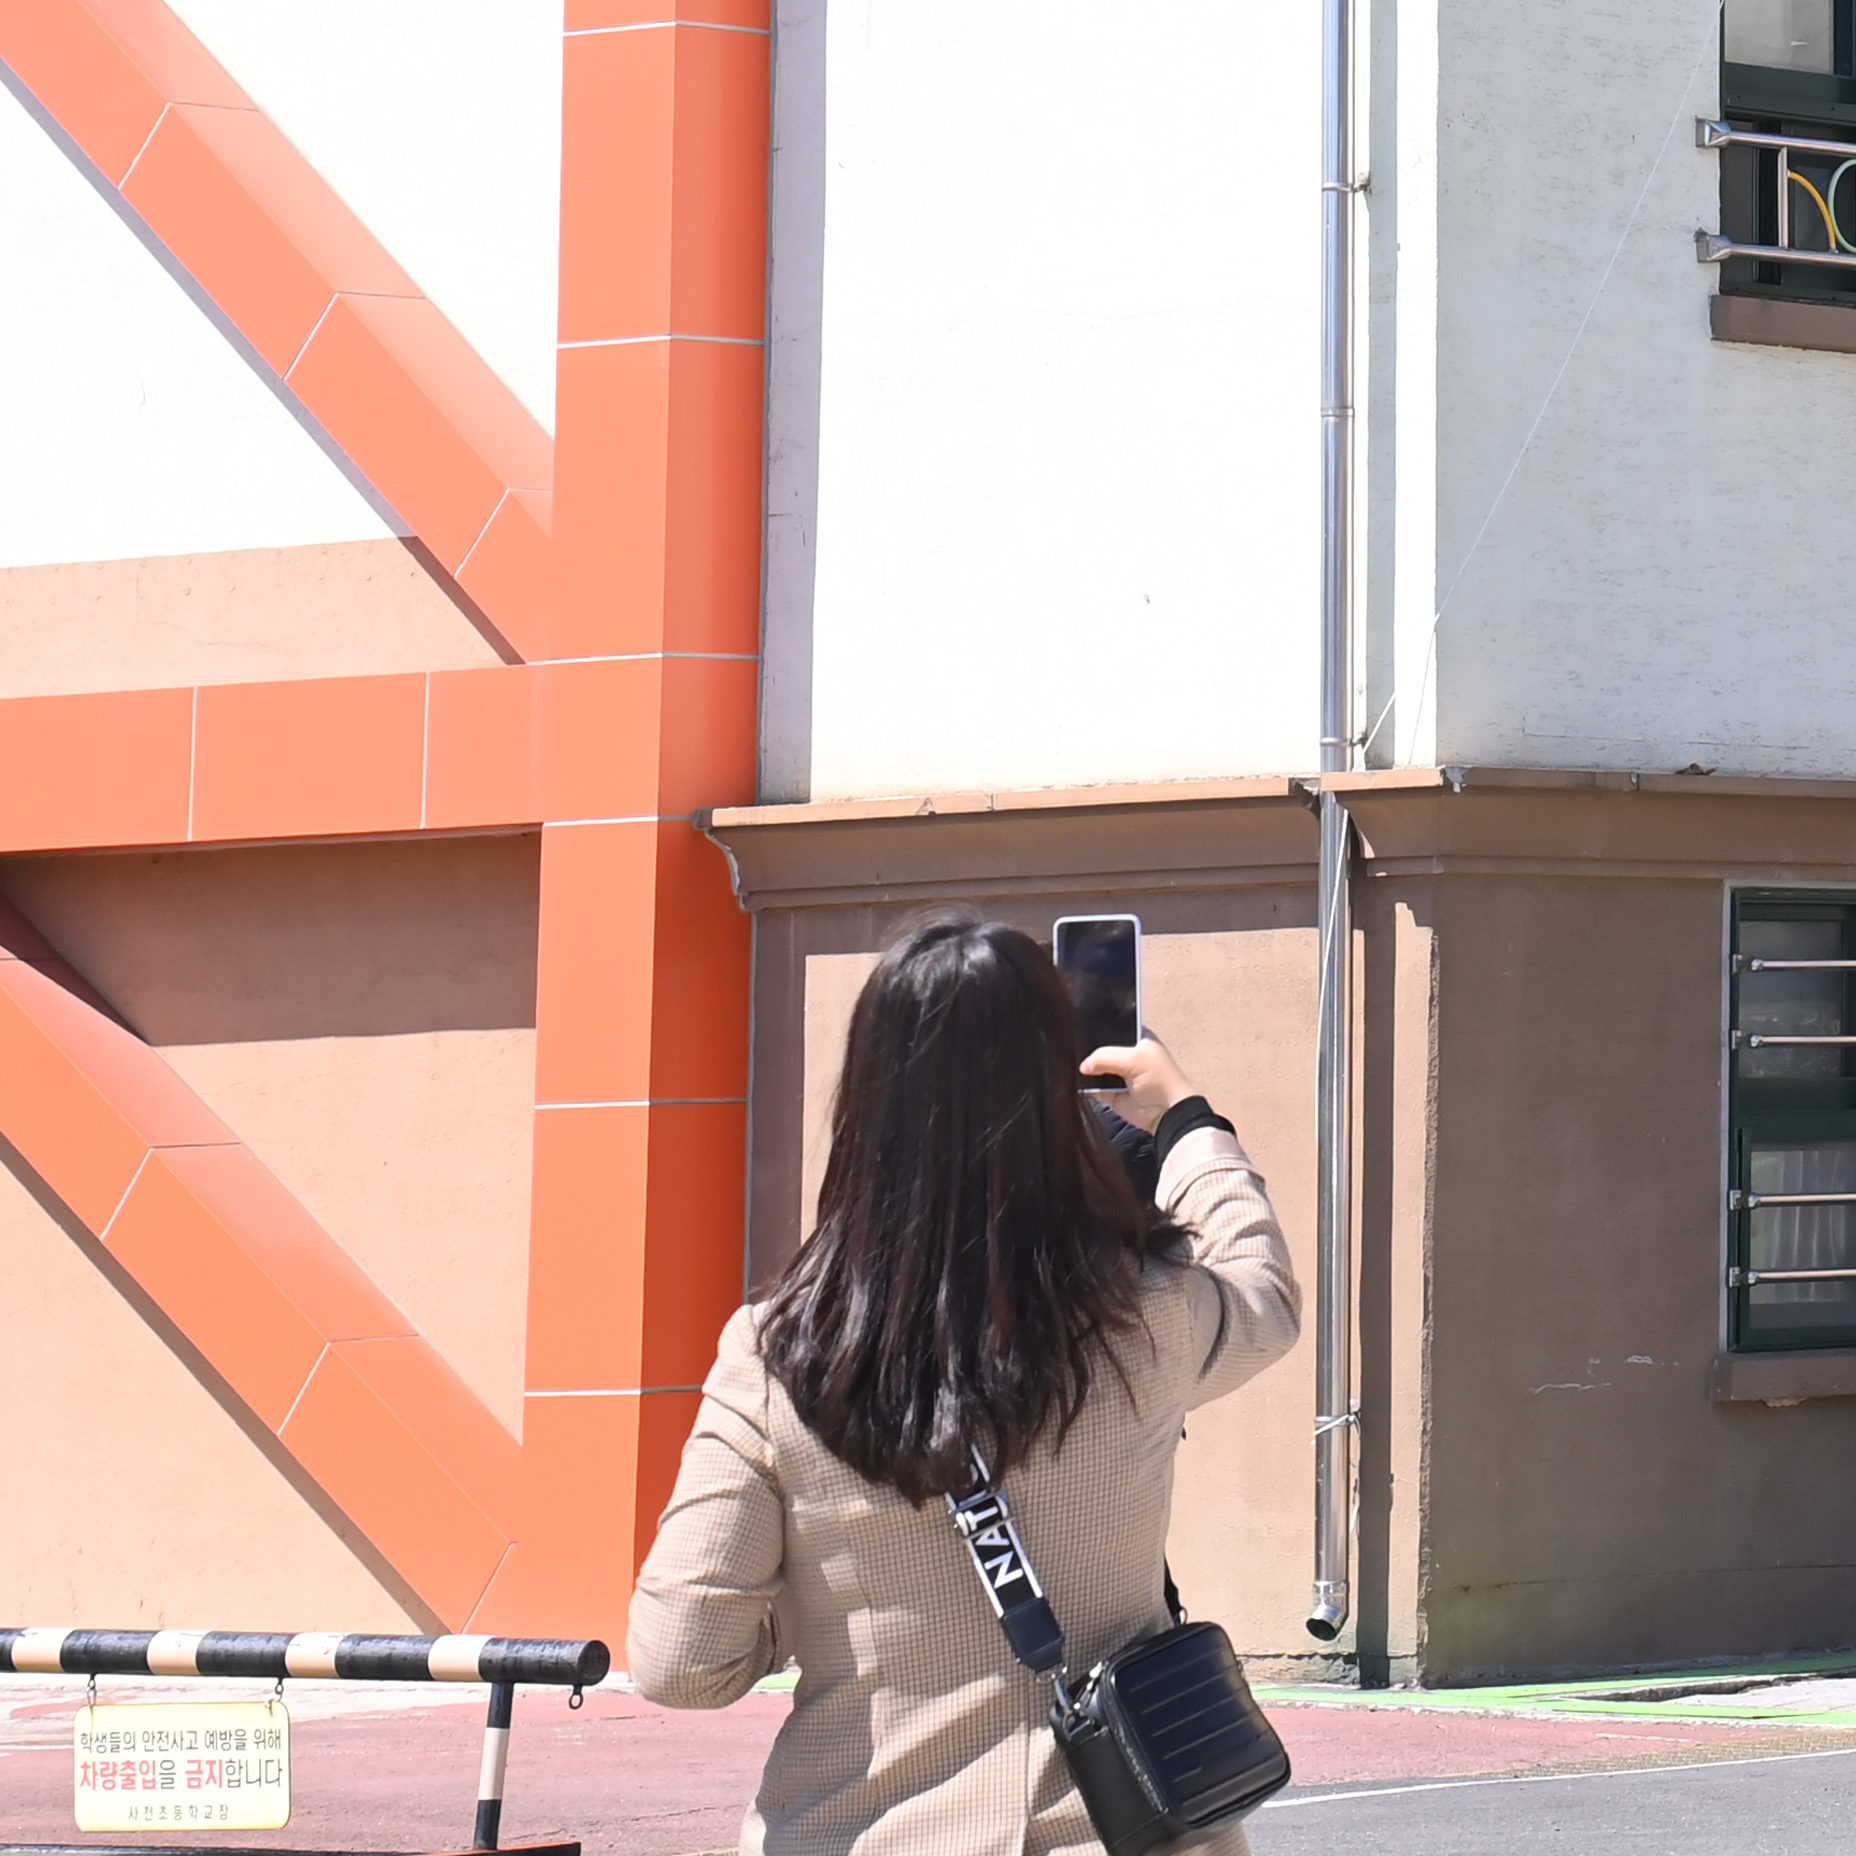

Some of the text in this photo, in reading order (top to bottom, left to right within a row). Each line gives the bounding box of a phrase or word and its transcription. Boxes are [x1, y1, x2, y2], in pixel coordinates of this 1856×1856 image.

[80, 1728, 281, 1754] 학생들의 안전사고 예방을 위해
[80, 1758, 283, 1790] 차량출입을 금지합니다
